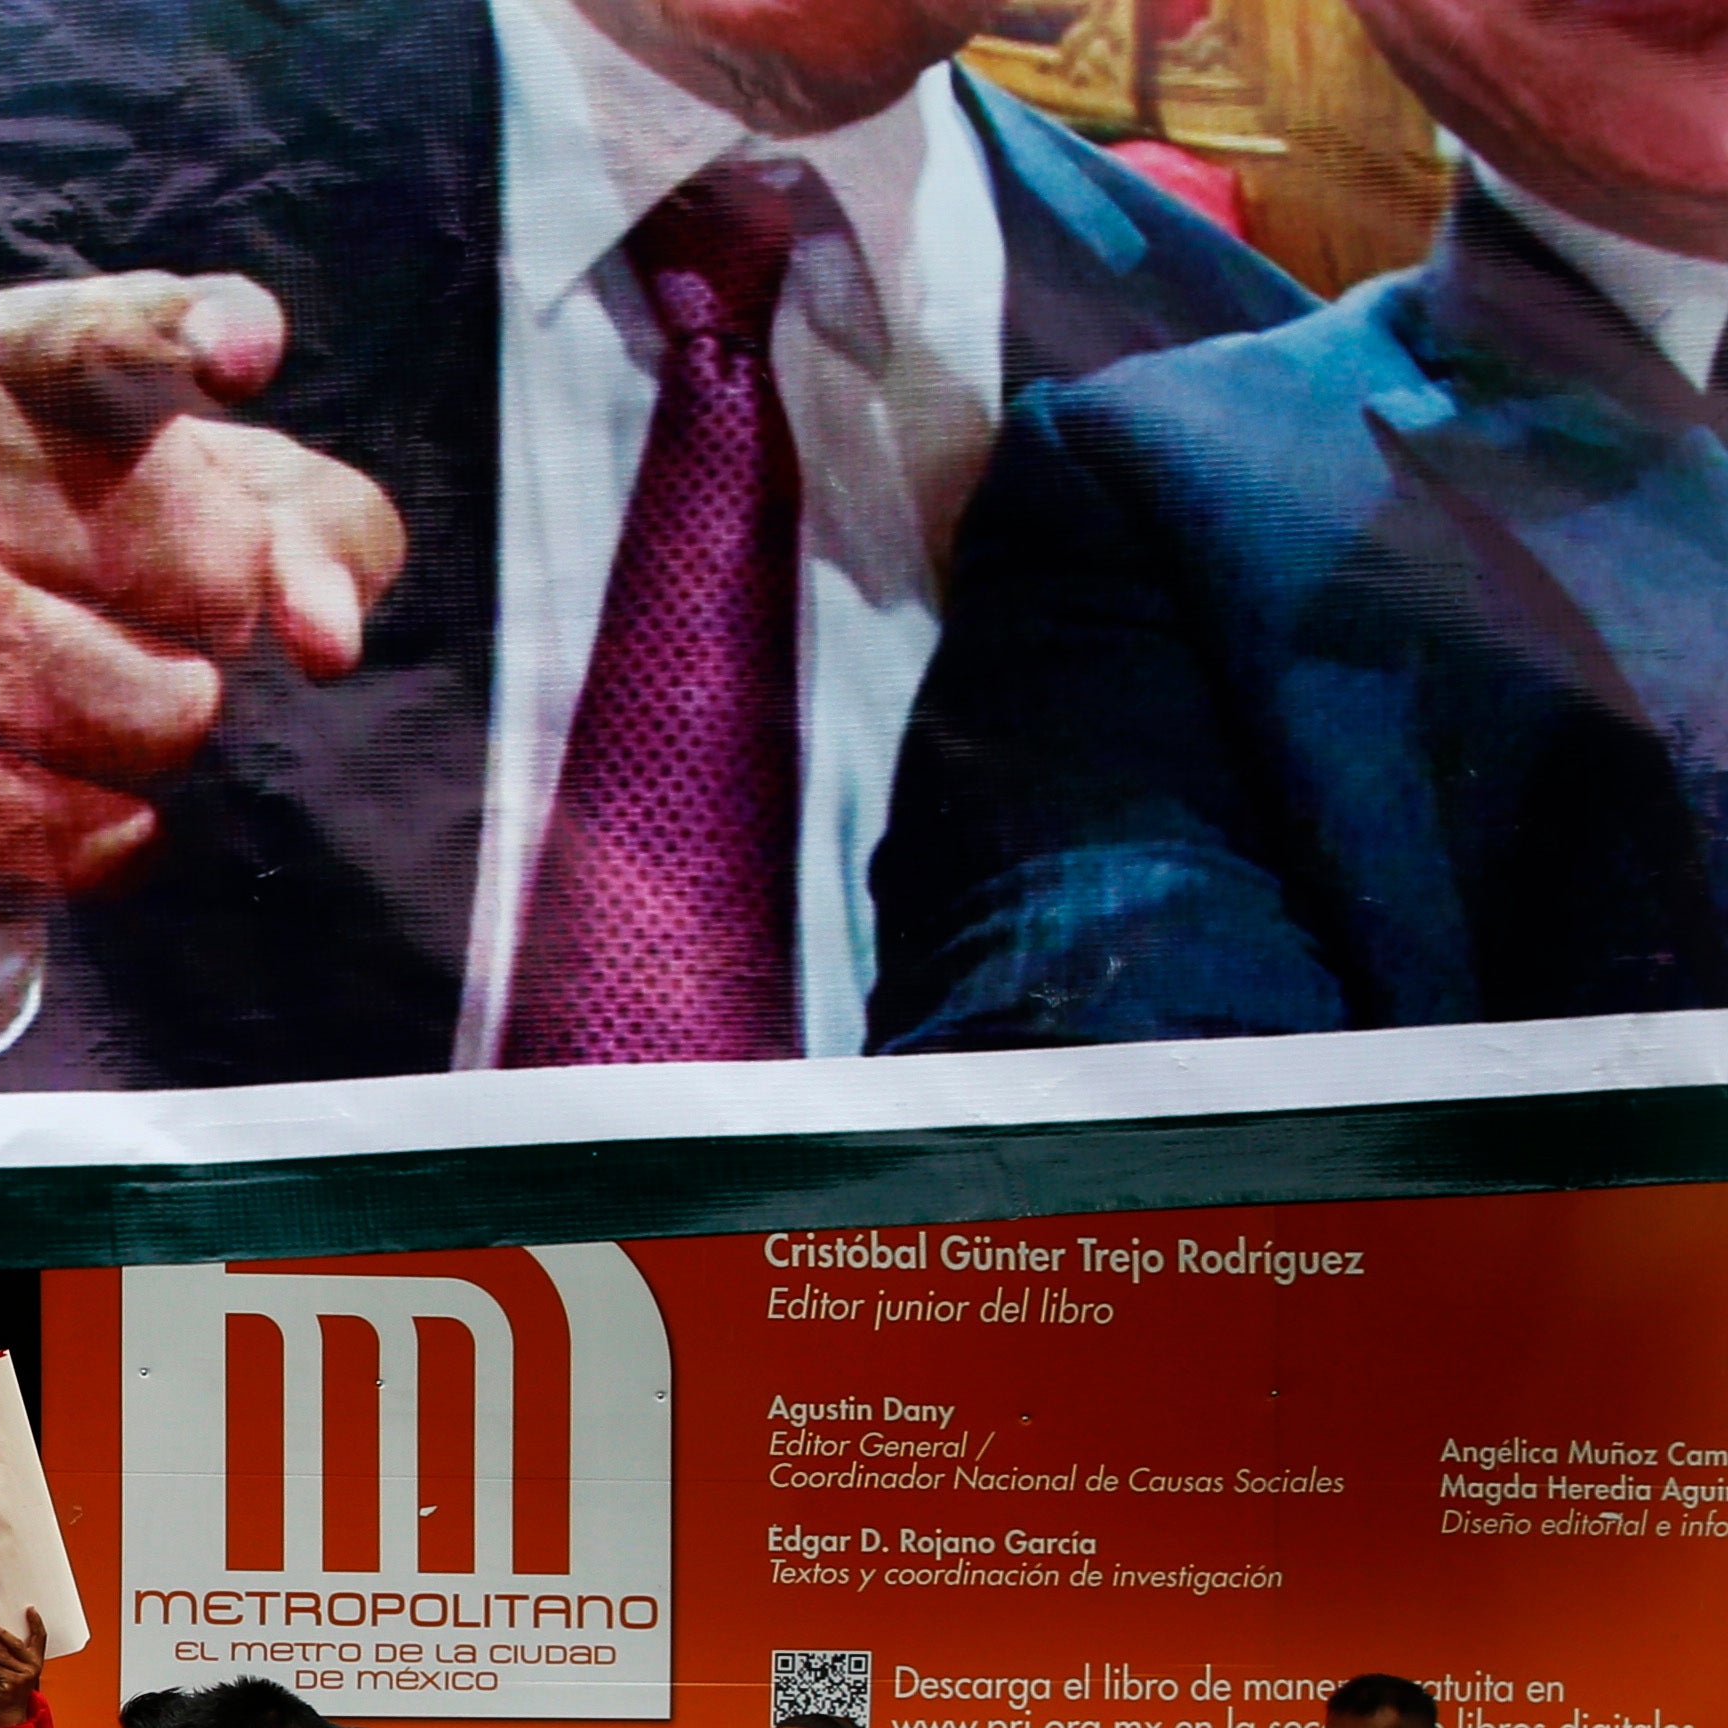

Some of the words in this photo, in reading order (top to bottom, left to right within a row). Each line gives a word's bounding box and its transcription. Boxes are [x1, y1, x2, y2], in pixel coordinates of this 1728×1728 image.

[765, 1230, 926, 1271] Cristóbal
[941, 1235, 1065, 1272] Günter
[1078, 1237, 1164, 1284] Trejo
[1178, 1235, 1363, 1287] Rodríguez
[768, 1283, 863, 1320] Editor
[875, 1288, 970, 1331] junior
[980, 1286, 1029, 1323] del
[1041, 1287, 1113, 1324] libro
[884, 1397, 954, 1429] Dany
[770, 1428, 850, 1457] Editor
[860, 1430, 967, 1458] General
[1441, 1436, 1557, 1470] Angélica
[1569, 1441, 1657, 1465] Muñoz
[770, 1460, 944, 1489] Coordinador
[954, 1463, 1077, 1491] Nacional
[1086, 1464, 1118, 1492] de
[1129, 1468, 1223, 1493] Causas
[1235, 1465, 1344, 1494] Sociales
[1441, 1473, 1537, 1506] Magda
[1548, 1475, 1651, 1500] Heredia
[1442, 1510, 1531, 1534] Diseño
[1656, 1521, 1671, 1536] e
[861, 1528, 888, 1552] D.
[901, 1528, 995, 1561] Rojano
[1005, 1529, 1096, 1562] García
[772, 1556, 849, 1584] Textos
[857, 1568, 877, 1593] y
[885, 1557, 1059, 1586] coordinación
[1070, 1560, 1102, 1586] de
[1113, 1564, 1282, 1596] investigación
[134, 1589, 659, 1629] METROPOLITANO
[175, 1641, 219, 1662] EL
[894, 1664, 1051, 1710] Descarga
[1063, 1663, 1090, 1700] el
[1104, 1663, 1179, 1701] libro
[1190, 1663, 1232, 1702] de
[1526, 1681, 1564, 1703] en
